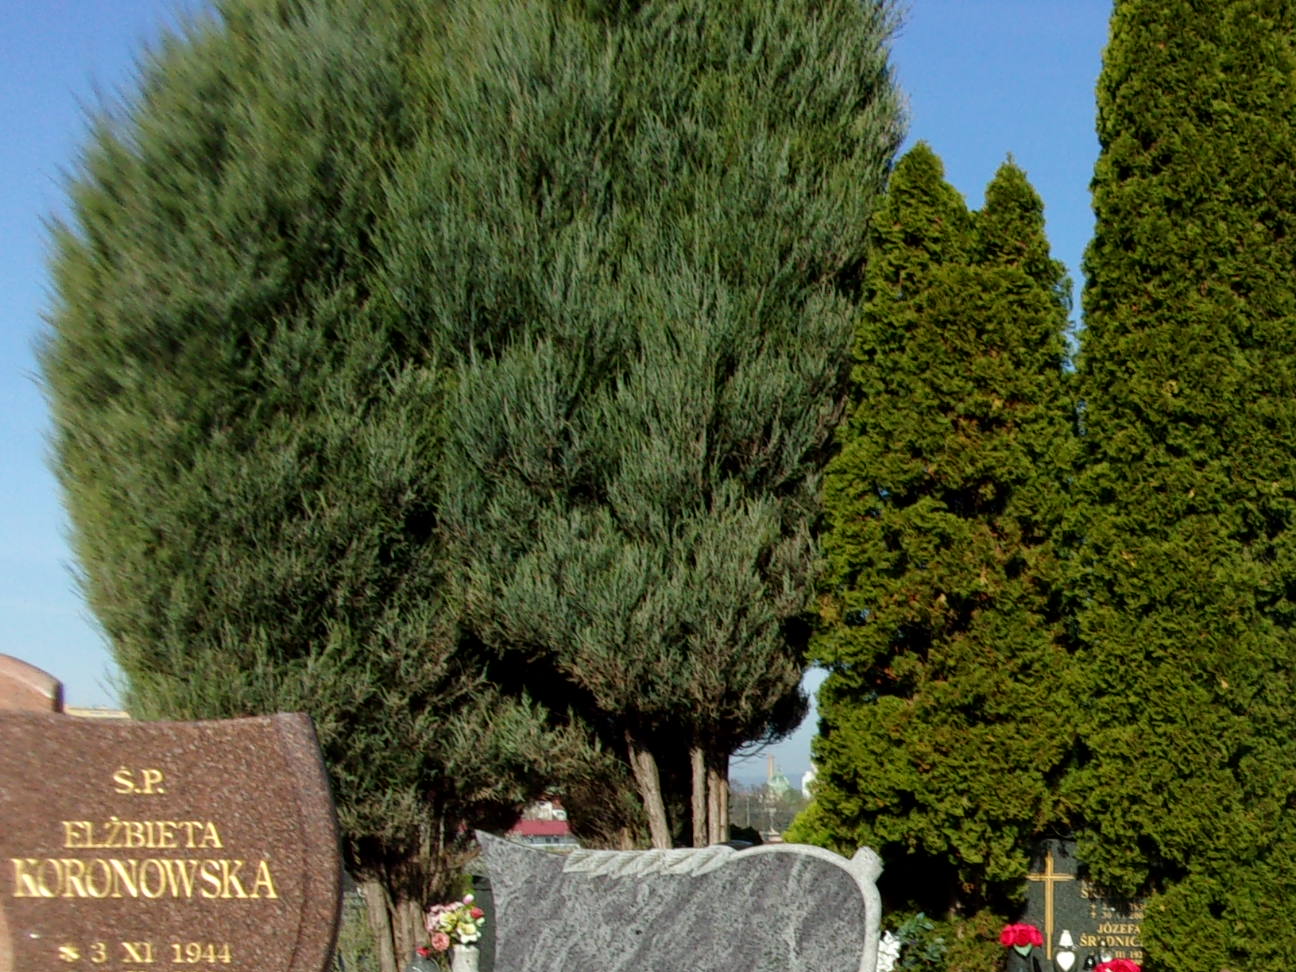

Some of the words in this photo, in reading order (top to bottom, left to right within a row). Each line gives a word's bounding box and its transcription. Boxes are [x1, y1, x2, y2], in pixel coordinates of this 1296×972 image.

[62, 817, 224, 849] ELŻBIETA
[10, 858, 278, 899] KORONOWSKA
[1097, 922, 1141, 934] JÓZEFA
[91, 943, 107, 963] 3
[122, 942, 154, 963] XI
[171, 943, 232, 963] 1944
